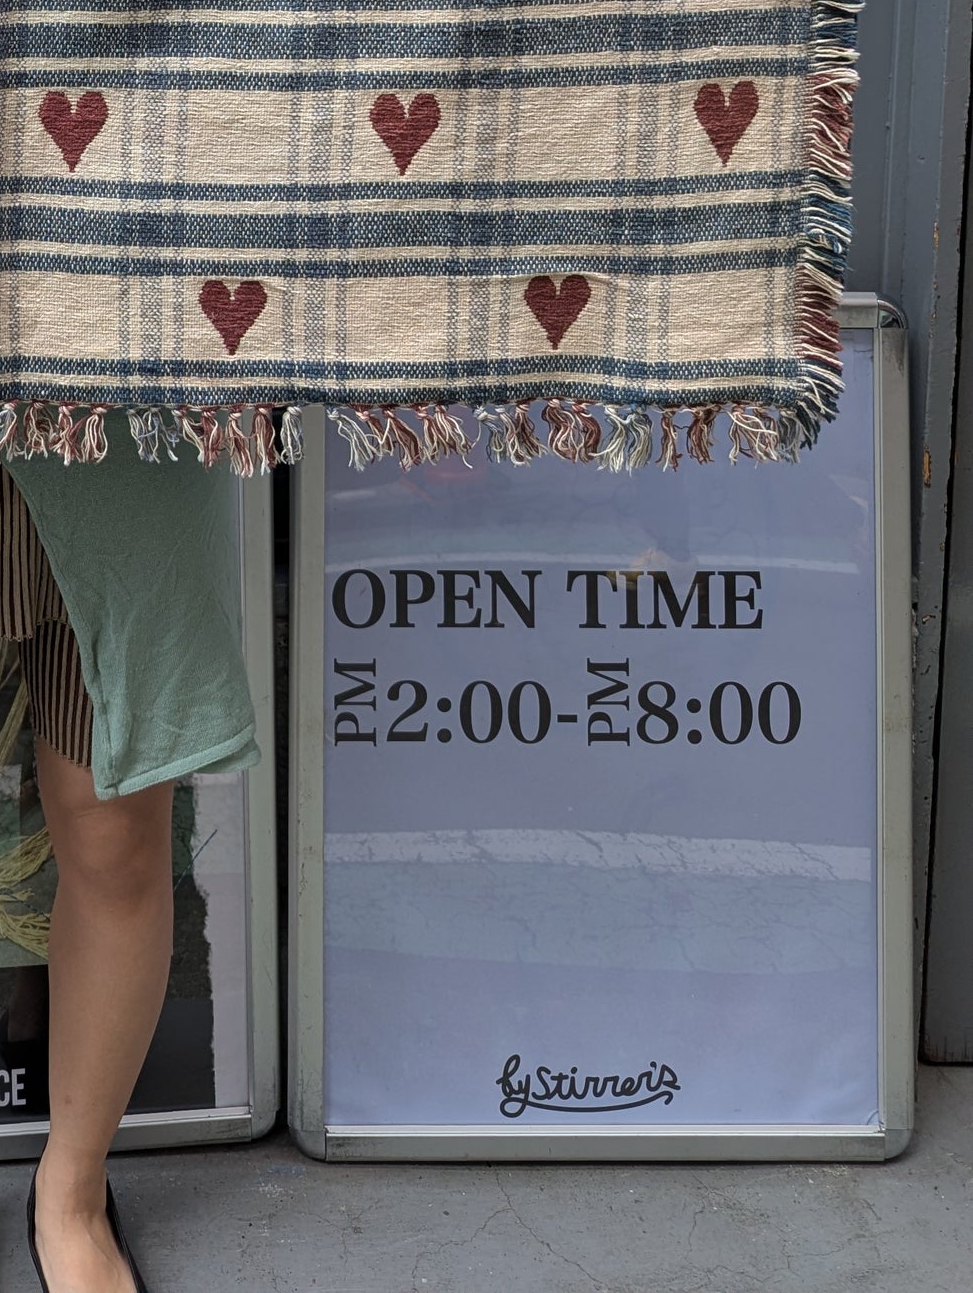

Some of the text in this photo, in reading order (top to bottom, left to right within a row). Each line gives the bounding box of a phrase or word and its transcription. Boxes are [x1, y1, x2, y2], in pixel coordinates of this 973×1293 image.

[331, 569, 763, 630] OPEN TIME
[333, 658, 377, 747] PM
[586, 658, 630, 747] PM
[636, 680, 802, 745] 8:00
